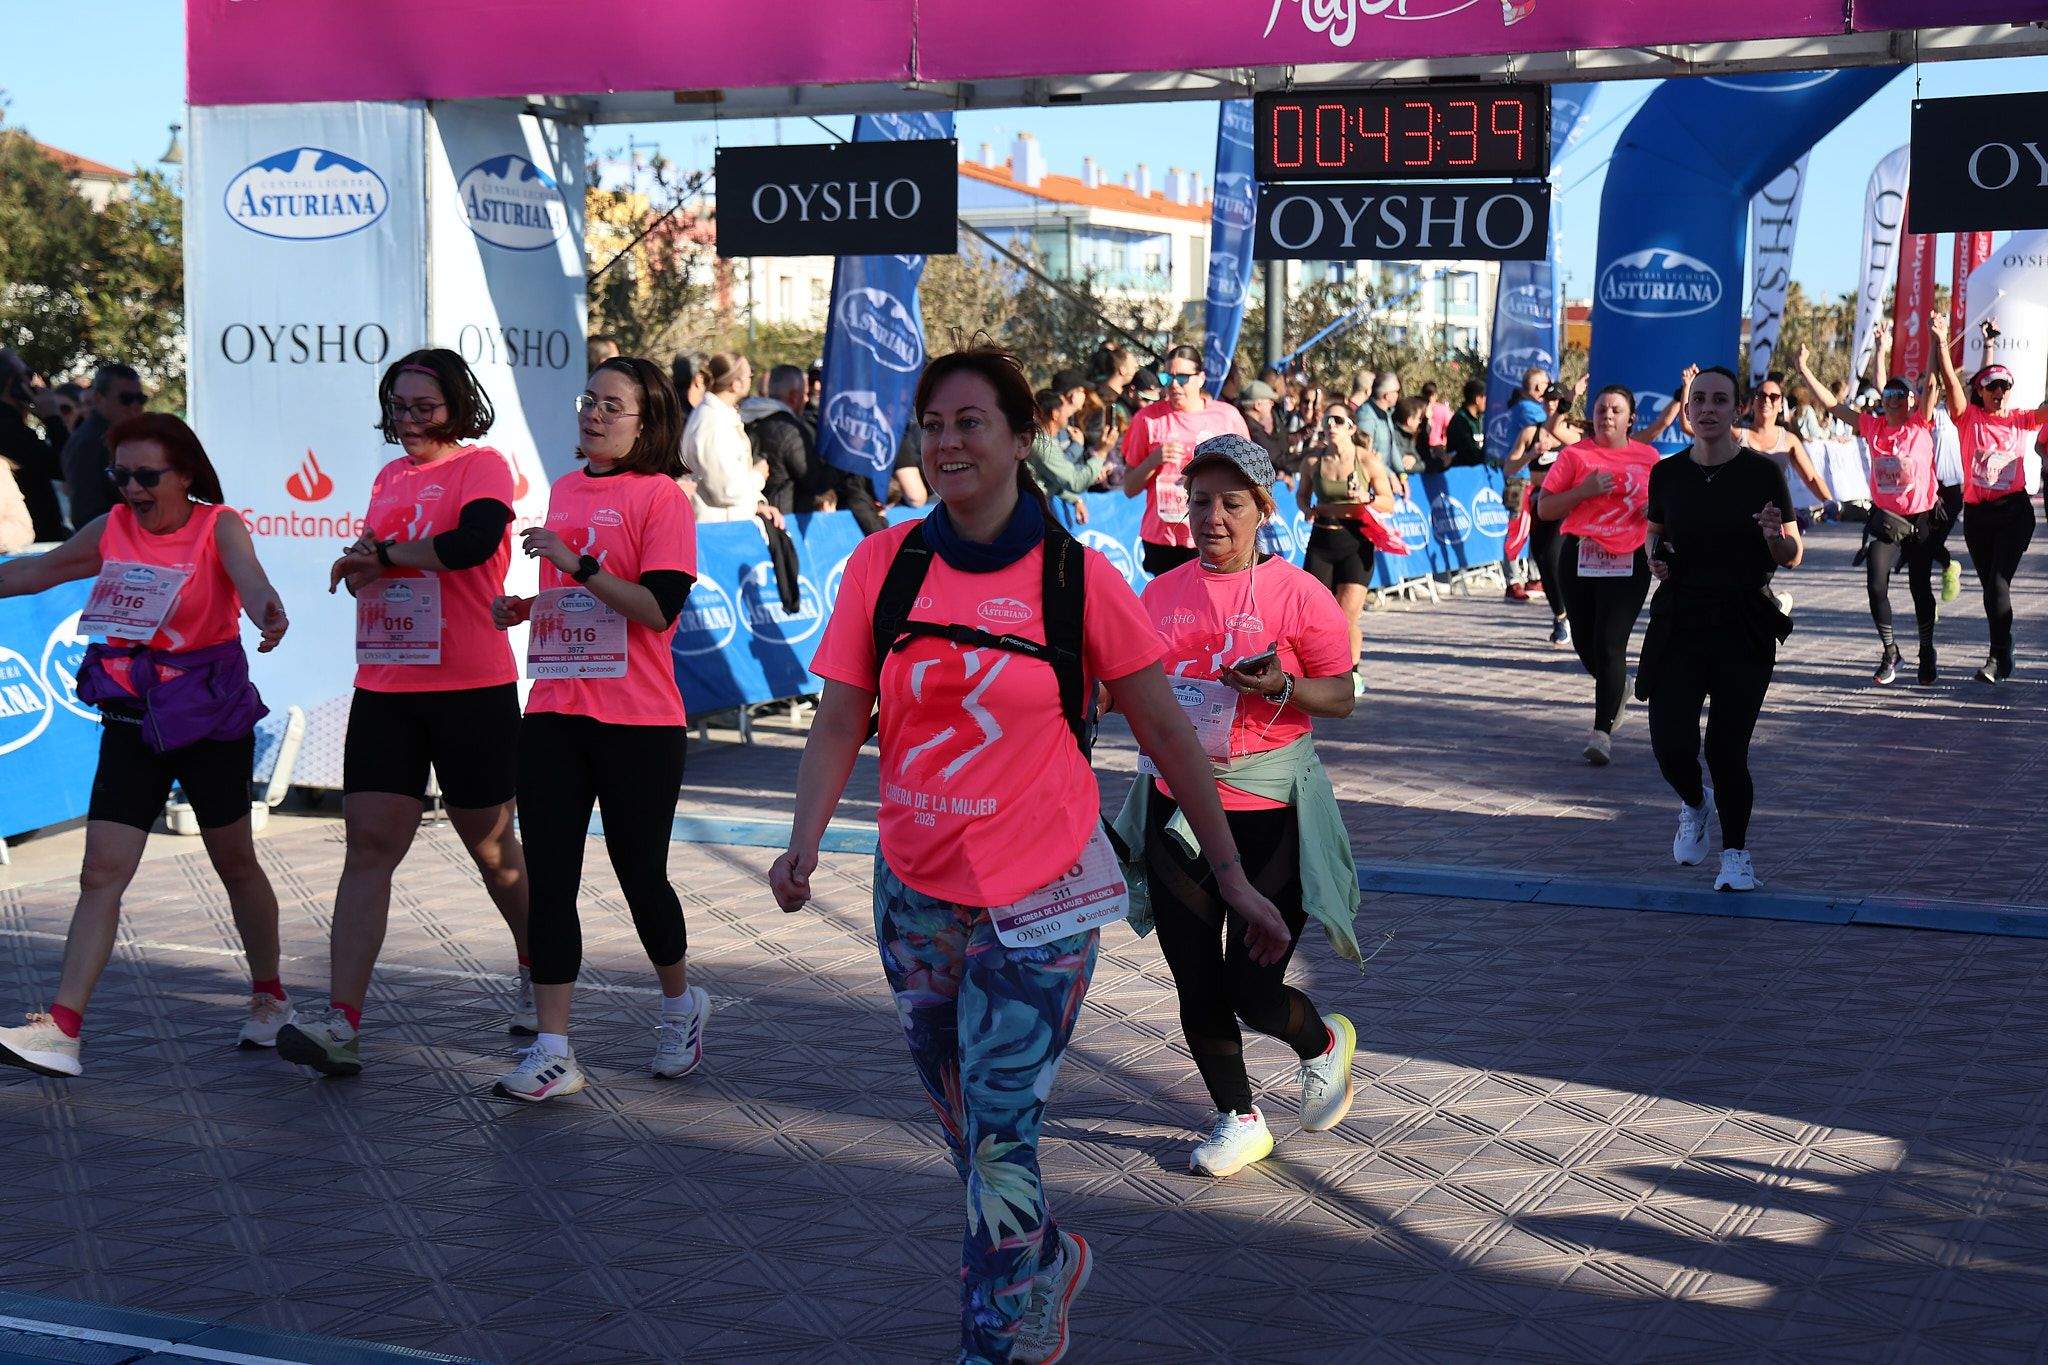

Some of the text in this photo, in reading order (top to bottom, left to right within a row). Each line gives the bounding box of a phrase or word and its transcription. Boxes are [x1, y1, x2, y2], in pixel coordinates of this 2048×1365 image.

[1273, 100, 1524, 168] 00:43:39
[239, 184, 376, 218] ASTURIANA
[751, 178, 921, 224] OYSHO
[1270, 194, 1534, 250] OYSHO
[1605, 275, 1713, 302] ASTURIANA
[221, 324, 390, 365] OYSHO
[459, 324, 570, 370] OYSHO
[1970, 338, 2029, 351] OSHO
[243, 508, 364, 538] Santande
[112, 594, 145, 609] 016
[981, 604, 1029, 619] ASTURIANA
[384, 616, 415, 631] 016
[561, 627, 597, 643] 016
[567, 646, 585, 654] 3972
[537, 665, 569, 674] OYSHO
[914, 791, 930, 810] DE
[932, 795, 948, 813] LA
[951, 797, 998, 816] MUJER
[914, 811, 936, 827] 2025
[1051, 887, 1072, 901] 311
[1013, 887, 1116, 926] CARRERA DE LA MUJER VALENCIA
[1015, 920, 1062, 944] OYSHO
